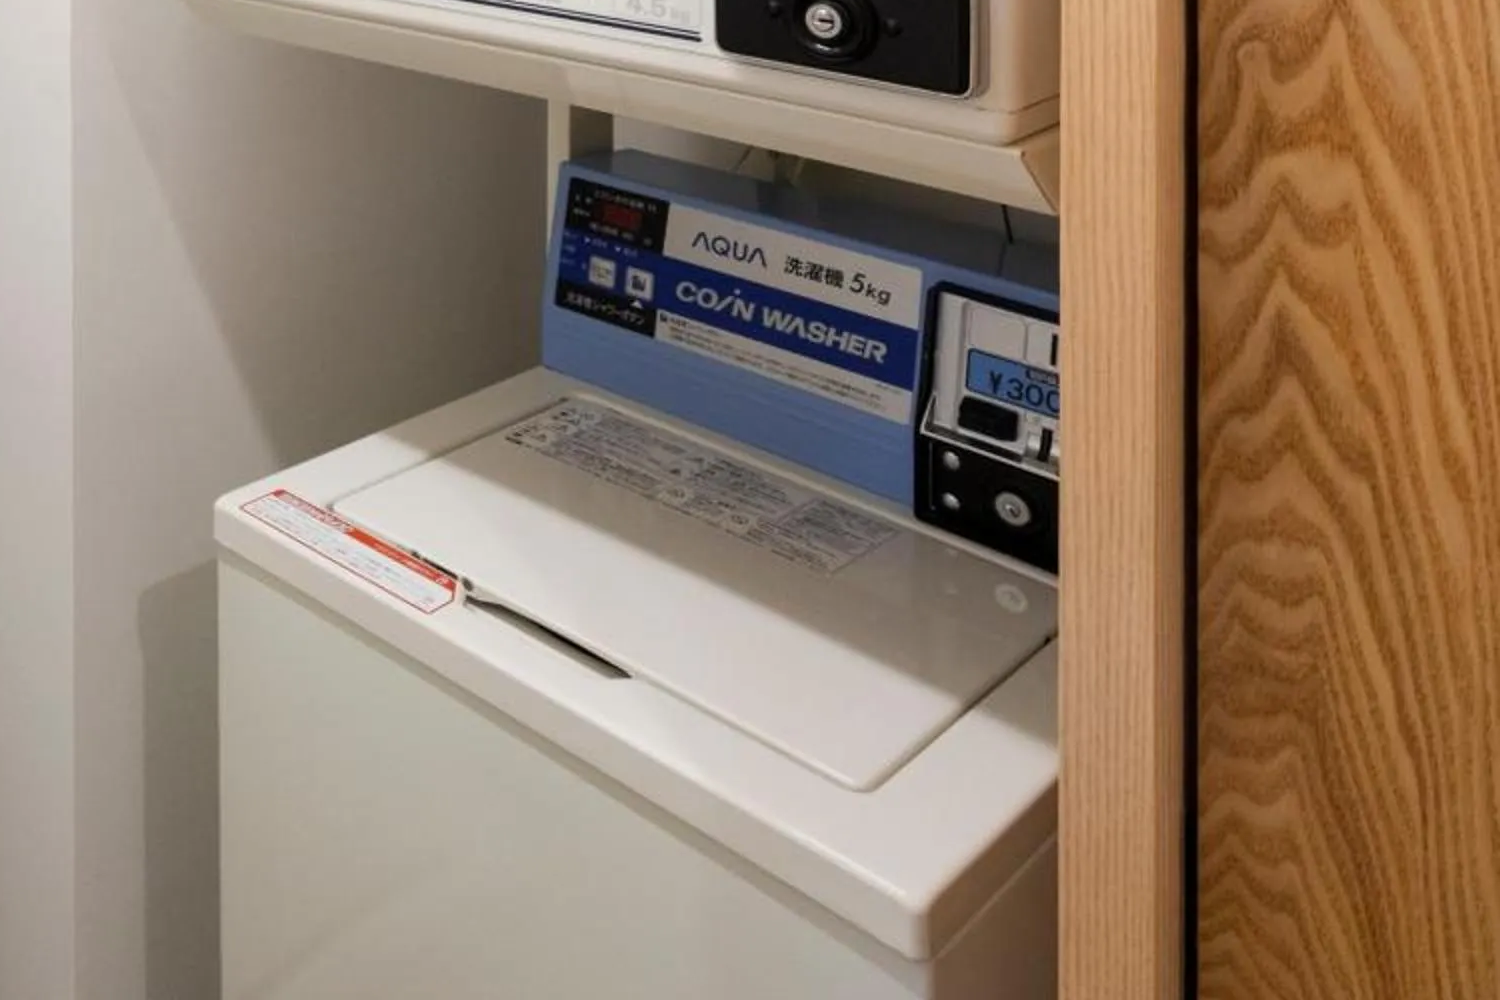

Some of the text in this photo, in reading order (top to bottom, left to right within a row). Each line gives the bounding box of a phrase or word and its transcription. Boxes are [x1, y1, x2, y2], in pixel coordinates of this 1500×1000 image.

[692, 231, 768, 270] AQUA
[784, 254, 845, 290] 洗濯機
[762, 304, 889, 363] WASHER
